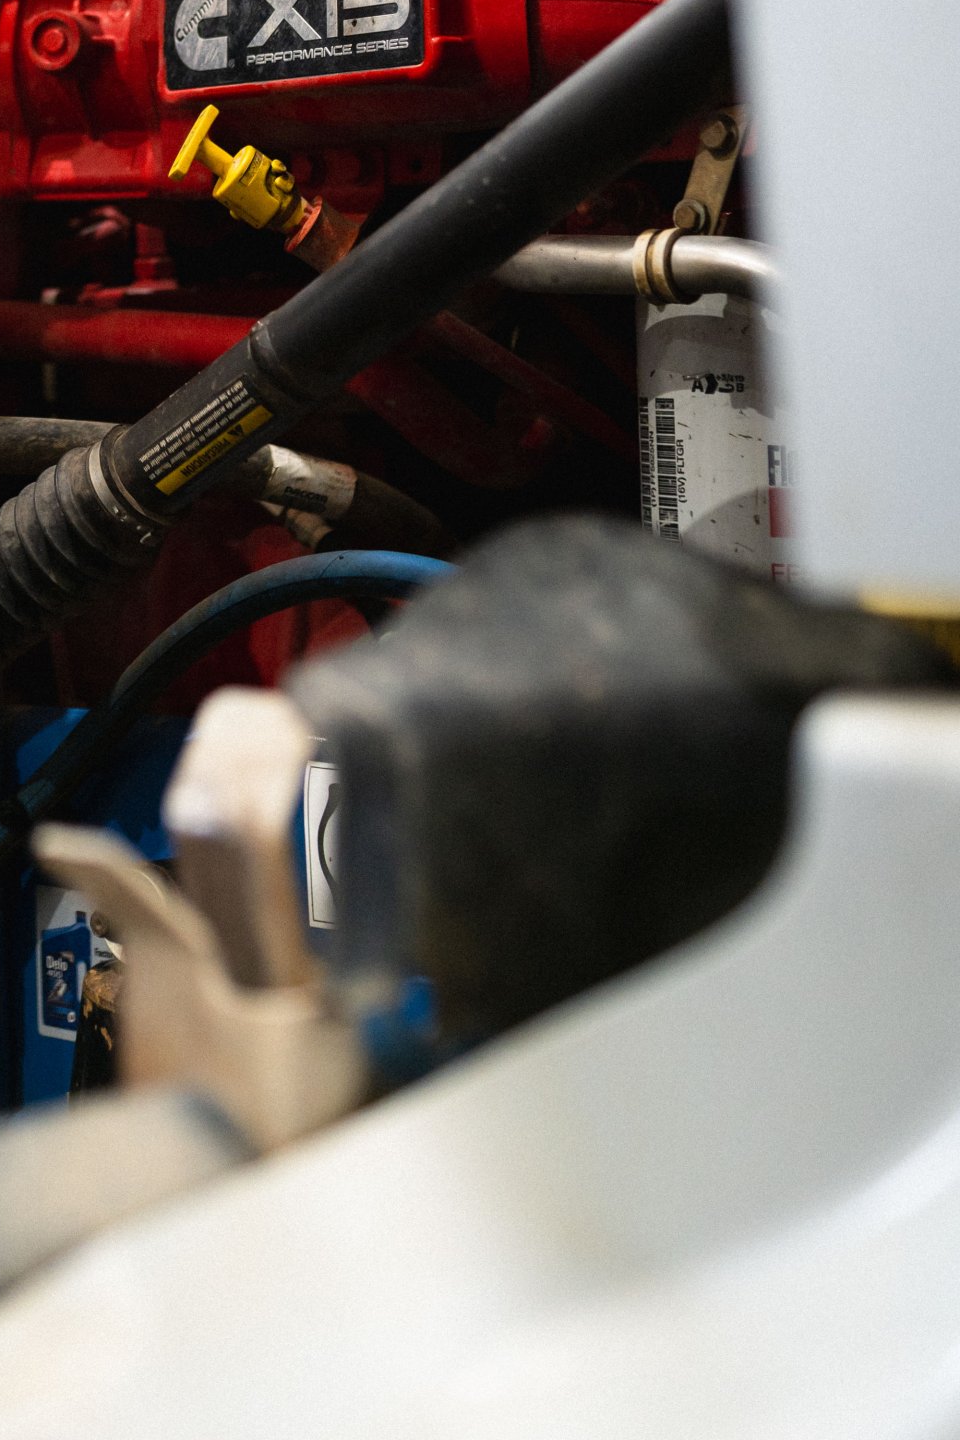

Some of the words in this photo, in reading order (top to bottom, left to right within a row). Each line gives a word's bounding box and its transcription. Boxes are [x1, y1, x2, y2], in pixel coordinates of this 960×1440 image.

[246, 43, 353, 67] PERFORMANCE
[355, 37, 409, 55] SERIES
[676, 439, 686, 475] FLTGR
[678, 477, 688, 504] (16V)
